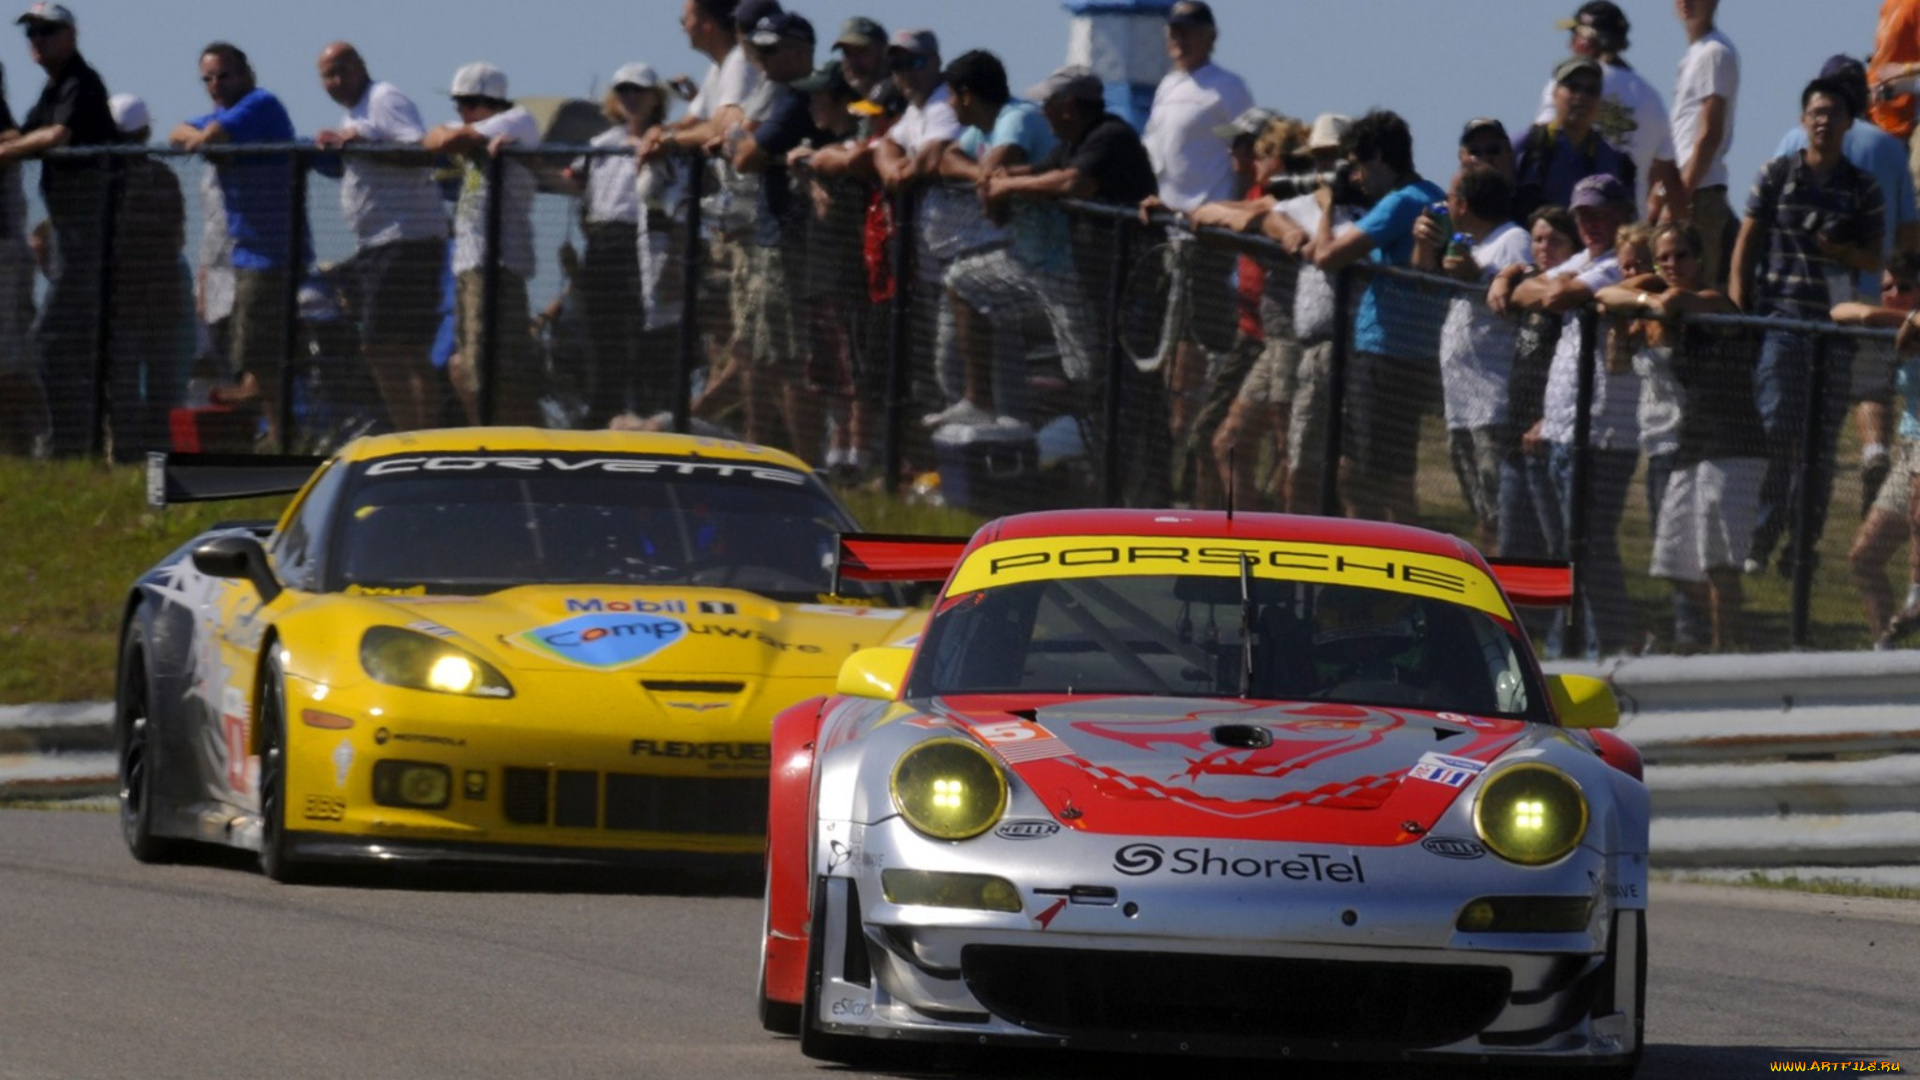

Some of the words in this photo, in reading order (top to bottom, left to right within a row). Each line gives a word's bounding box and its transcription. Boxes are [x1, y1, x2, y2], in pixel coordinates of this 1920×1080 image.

[365, 456, 805, 485] CORVETTE
[989, 546, 1466, 594] PORSCHE
[566, 599, 686, 613] Mobil
[631, 739, 772, 759] FLEXFUE
[304, 794, 346, 821] BBS
[1170, 848, 1365, 883] ShoreTel
